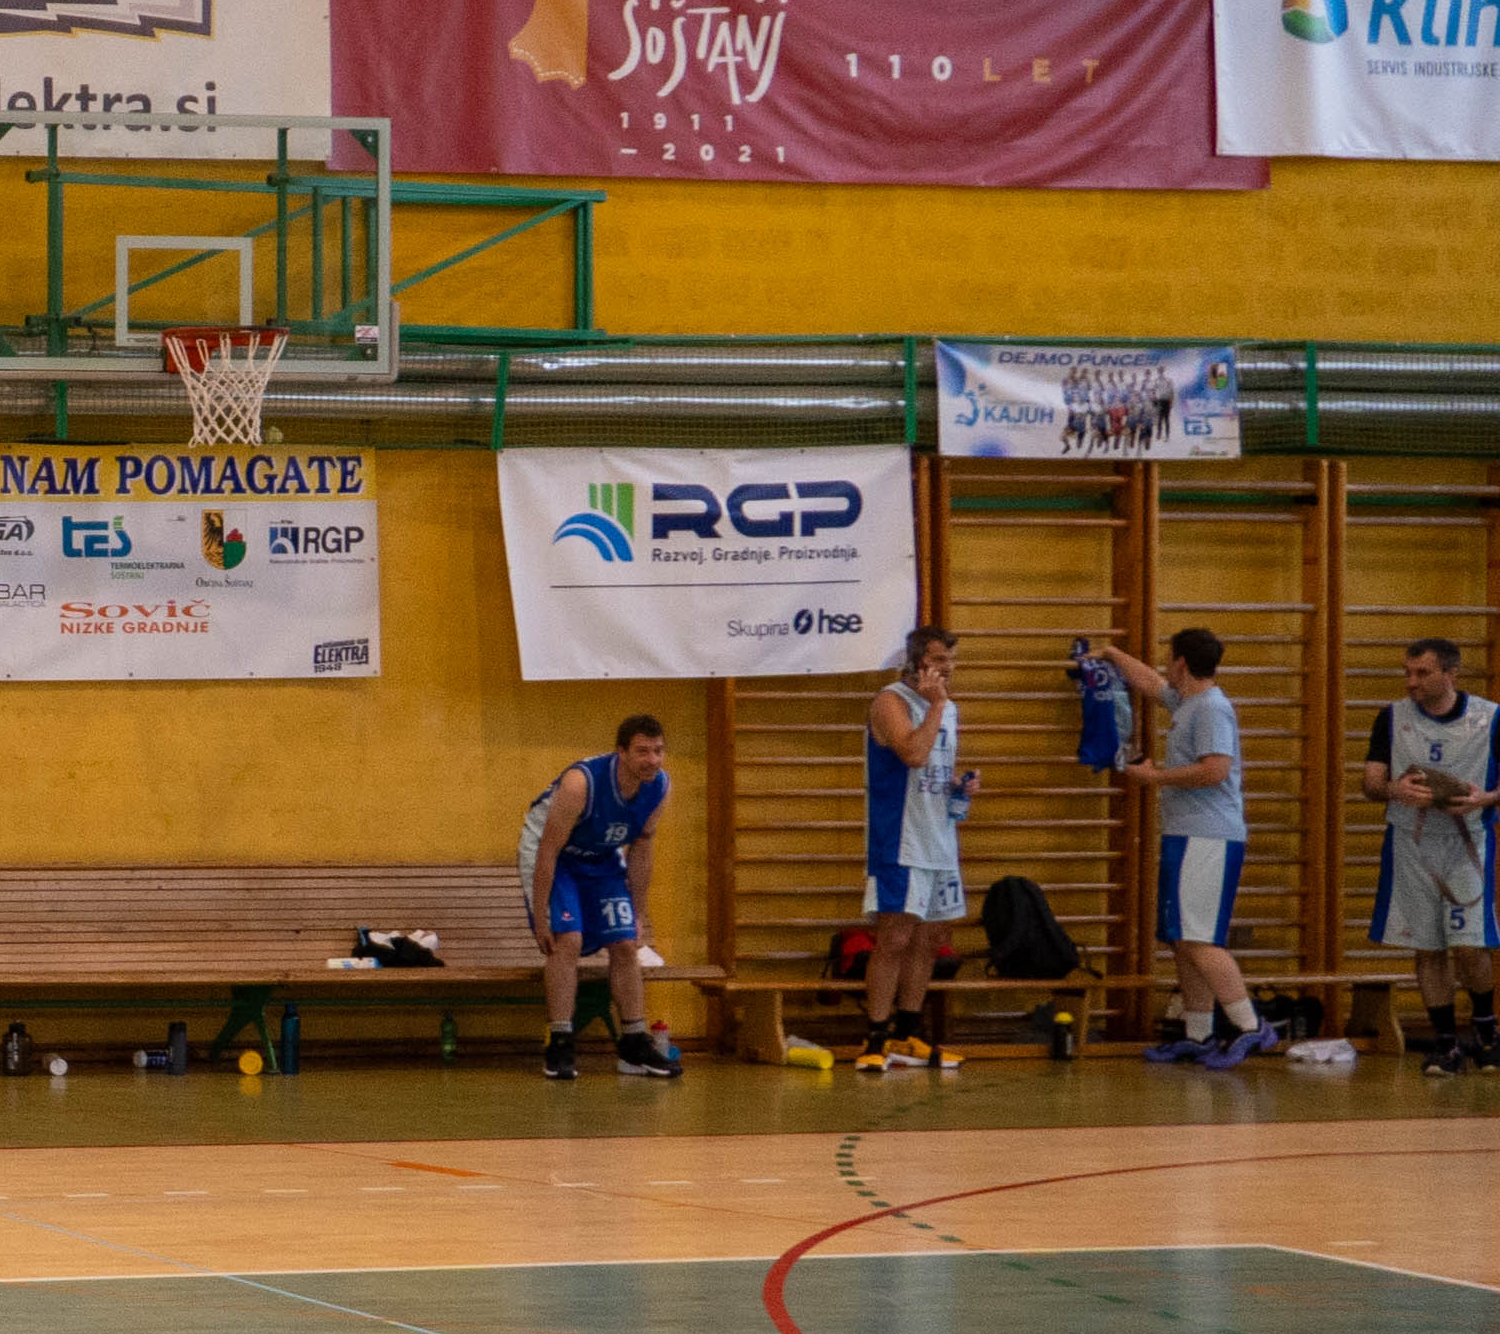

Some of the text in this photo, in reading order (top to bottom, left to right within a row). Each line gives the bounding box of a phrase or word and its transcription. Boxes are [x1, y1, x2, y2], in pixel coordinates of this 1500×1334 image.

[1366, 58, 1409, 76] SERVIS
[998, 349, 1073, 366] DEJMO
[982, 405, 1055, 425] KAJUH
[0, 454, 102, 496] NAM
[114, 454, 365, 496] POMAGATE
[651, 479, 864, 540] RGP
[302, 525, 365, 554] RGP
[651, 547, 707, 566] Razvoj.
[711, 545, 776, 565] Gradnje.
[59, 620, 211, 635] NIZKE GRADNJE
[726, 608, 864, 641] Skupina hse
[1429, 743, 1444, 763] 5
[601, 900, 635, 927] 19
[1449, 908, 1466, 931] 5
